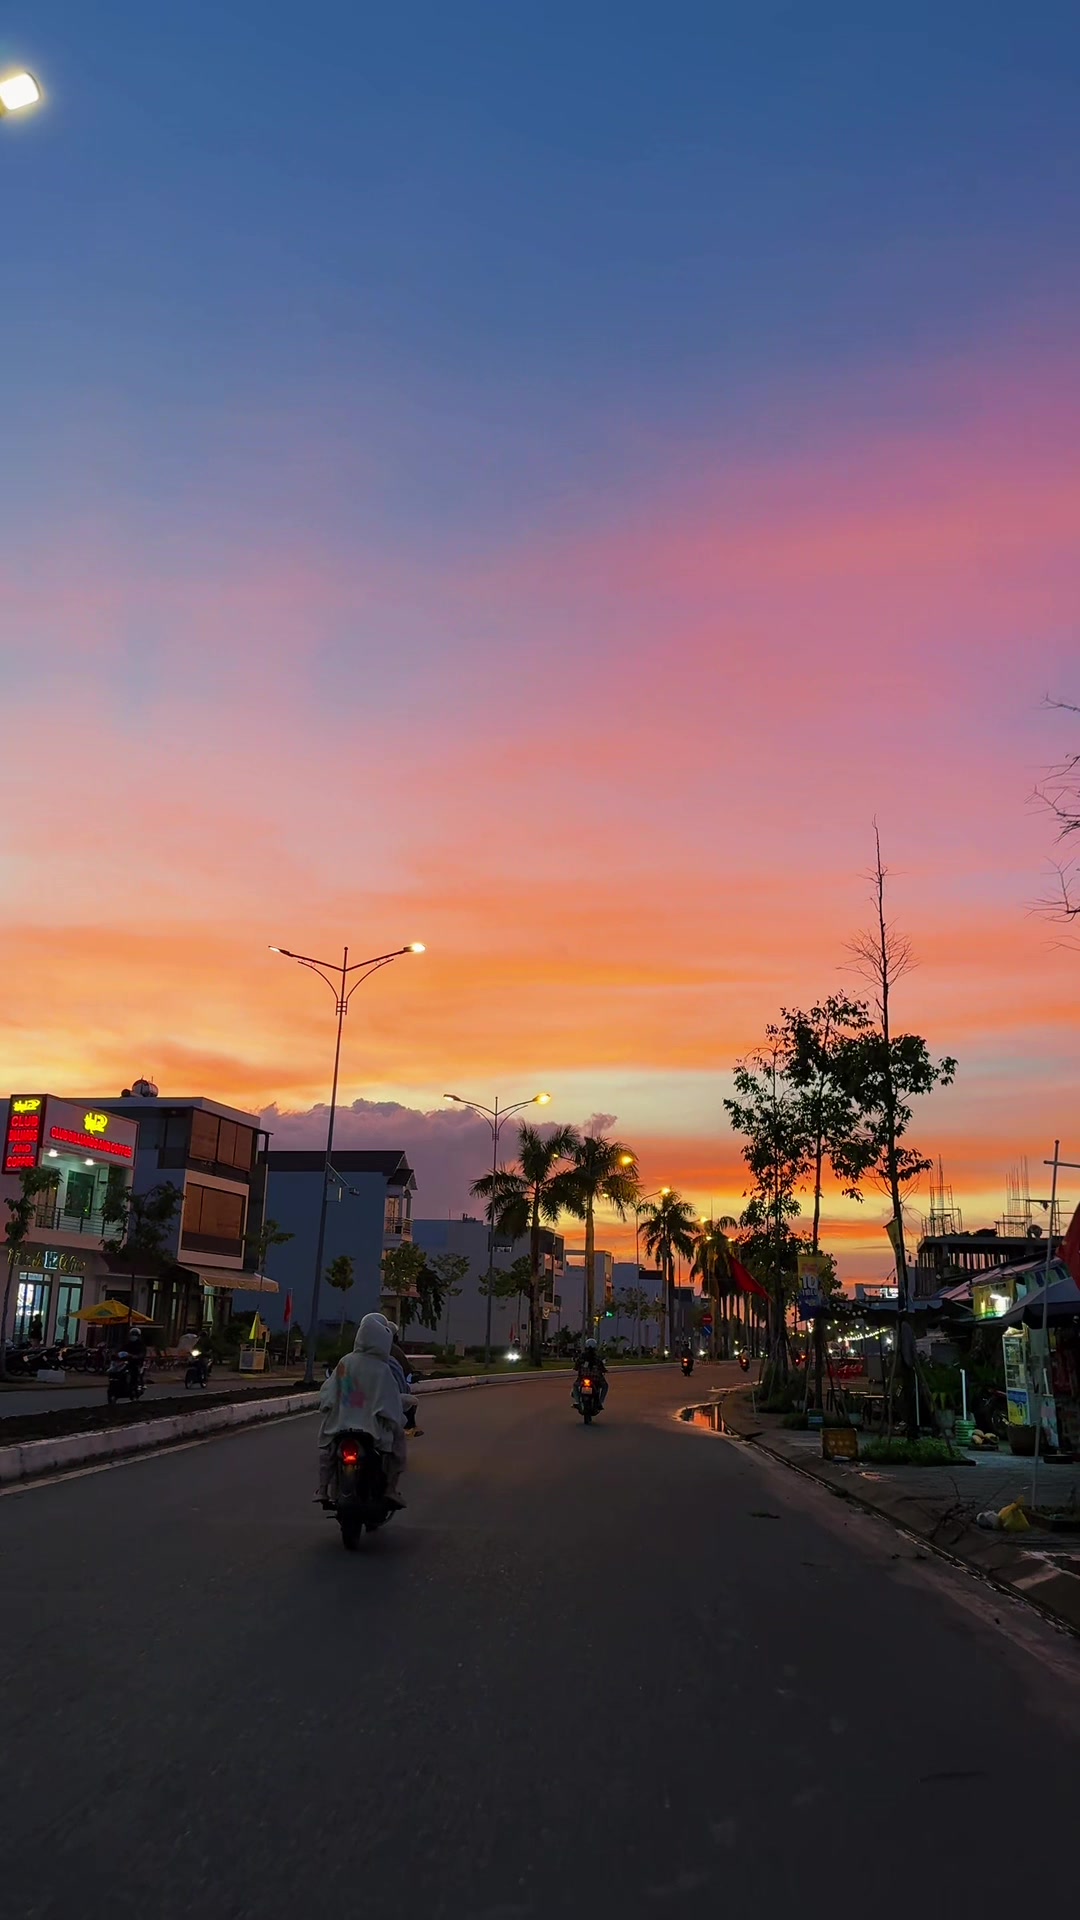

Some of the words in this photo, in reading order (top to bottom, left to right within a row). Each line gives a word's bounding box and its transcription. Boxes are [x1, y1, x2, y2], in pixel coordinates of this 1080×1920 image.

[11, 1115, 39, 1127] CLUB
[51, 1126, 68, 1141] CLUB
[98, 1140, 111, 1152] AND
[110, 1142, 132, 1158] COFFEE
[12, 1144, 31, 1153] AND
[6, 1156, 35, 1168] COFFEE
